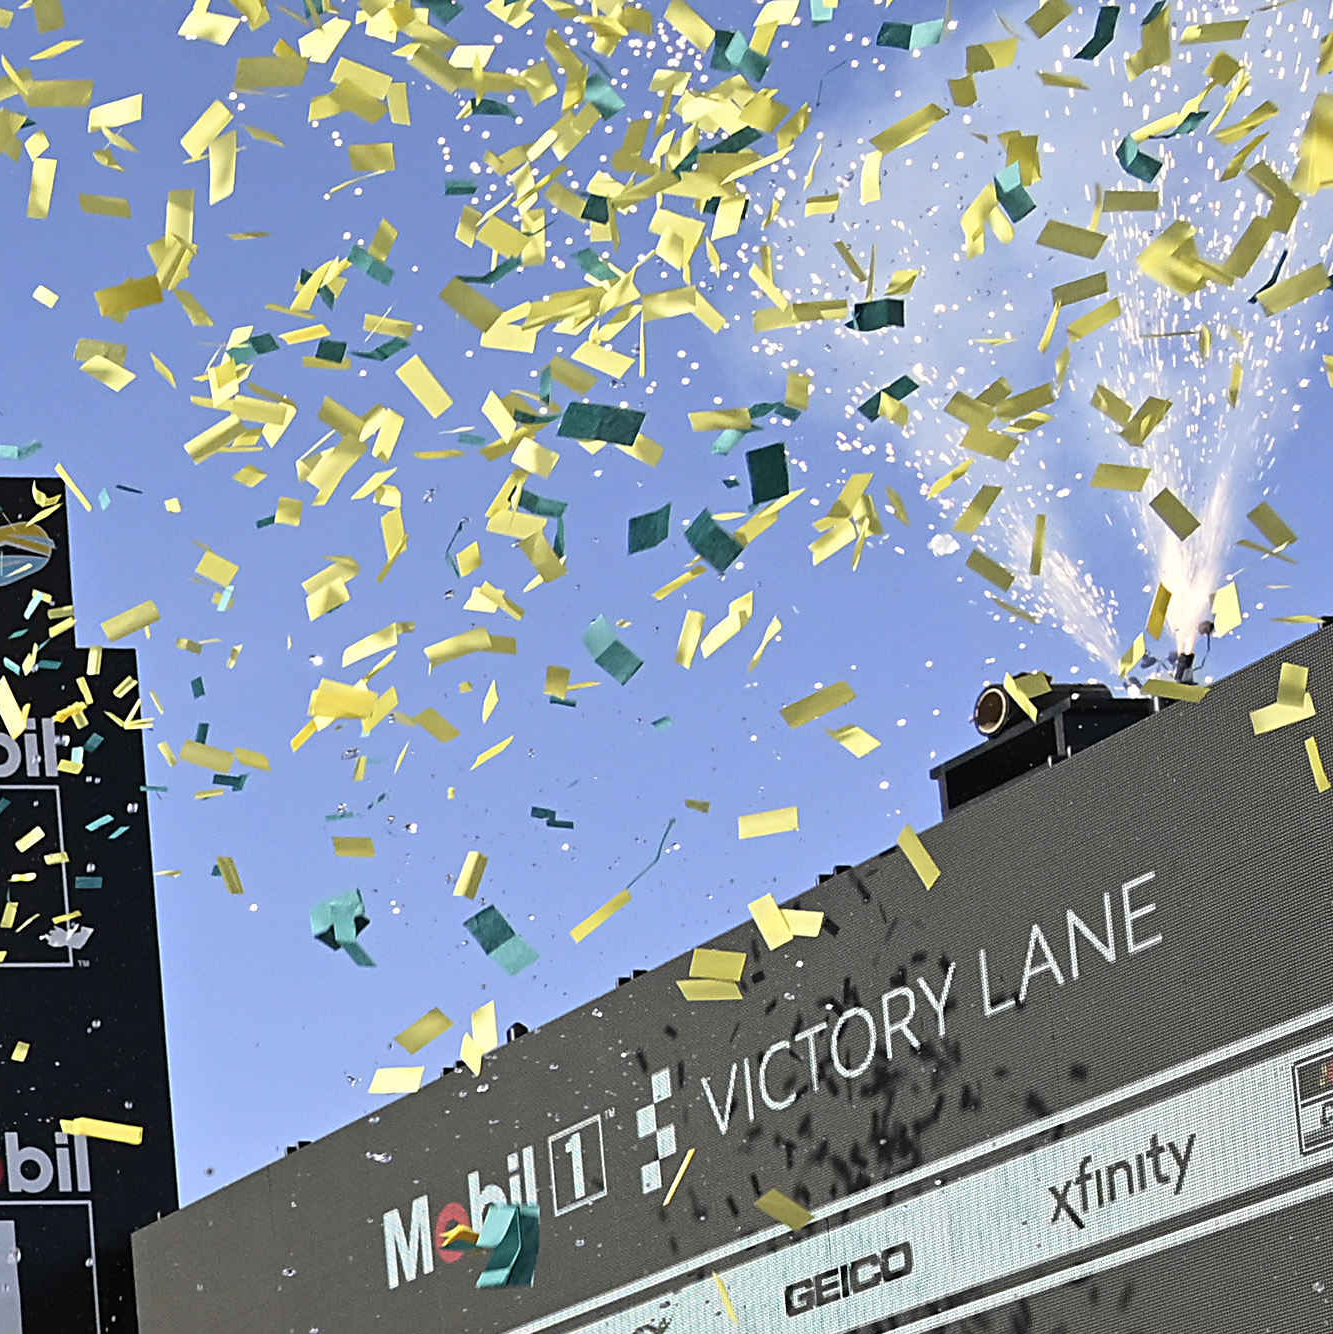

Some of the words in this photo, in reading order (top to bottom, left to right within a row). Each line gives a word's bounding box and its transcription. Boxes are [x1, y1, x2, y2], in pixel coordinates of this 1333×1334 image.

[701, 961, 956, 1135] VICTORY
[980, 871, 1163, 1017] LANE
[564, 1132, 586, 1201] 1
[1049, 1132, 1197, 1230] xfinity
[785, 1241, 914, 1316] GEICO
